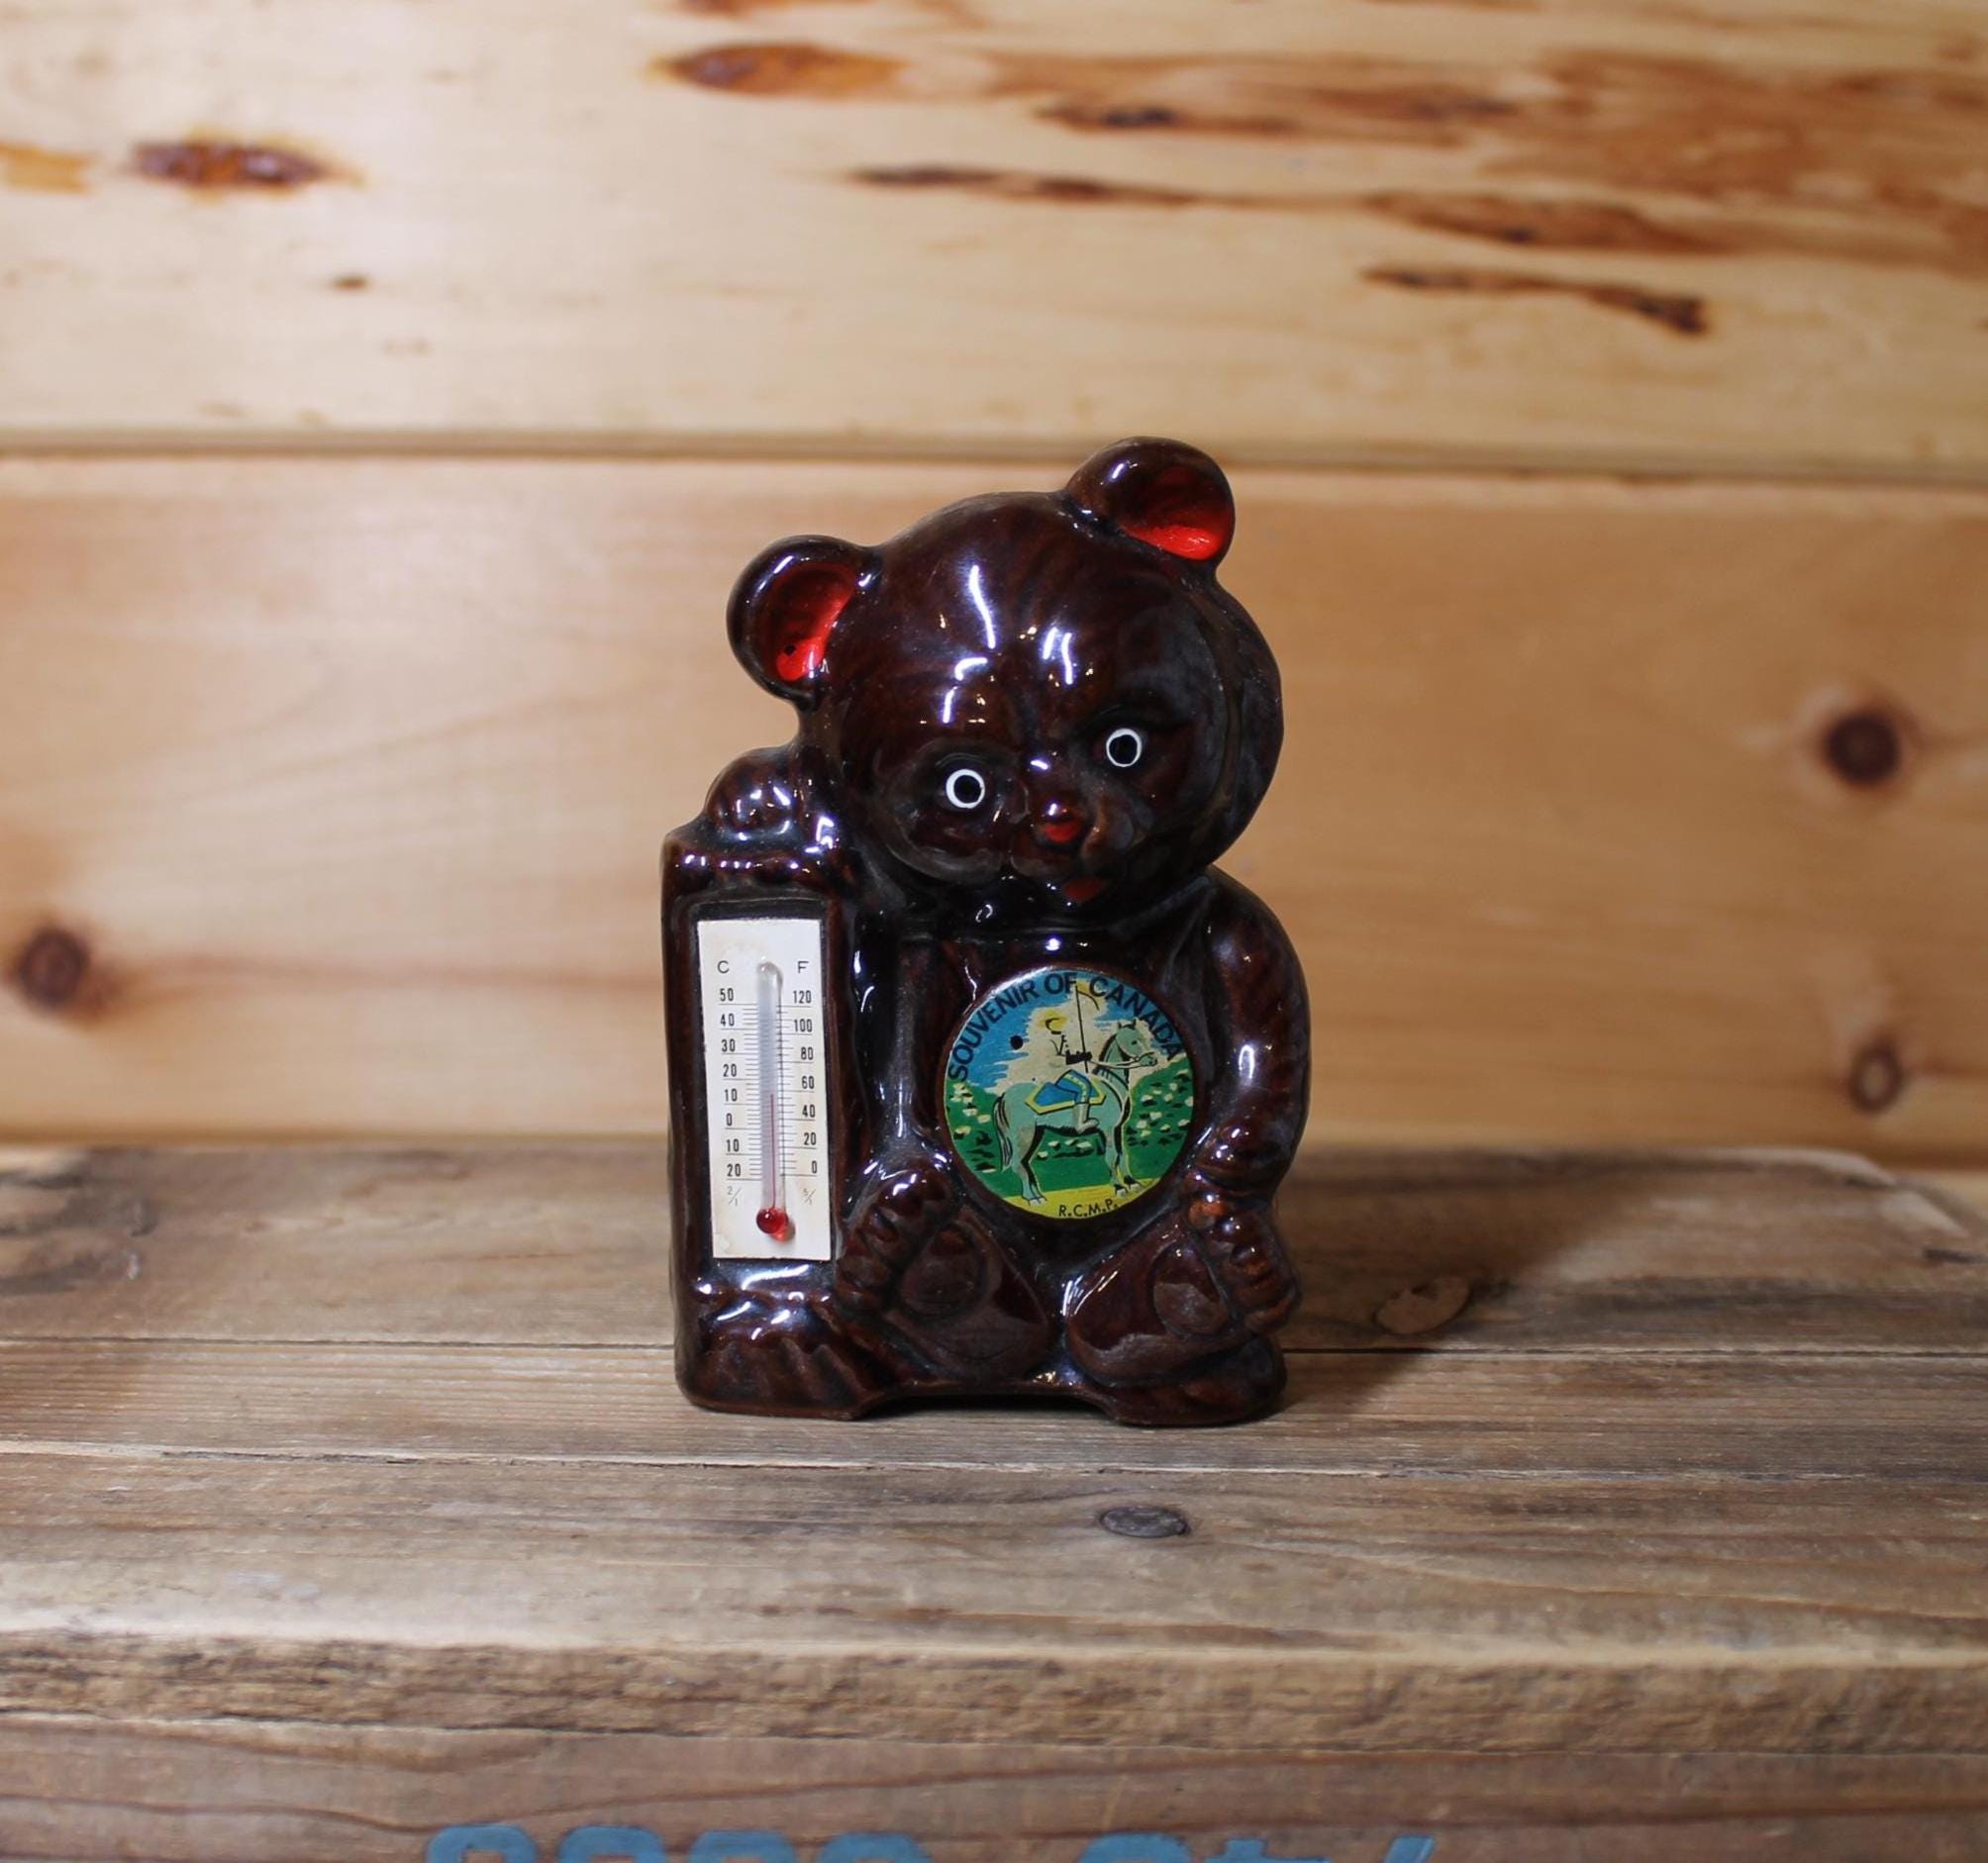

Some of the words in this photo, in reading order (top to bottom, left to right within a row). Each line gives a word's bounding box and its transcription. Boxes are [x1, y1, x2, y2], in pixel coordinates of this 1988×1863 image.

[717, 960, 730, 974] C
[797, 960, 809, 974] F
[720, 988, 735, 1002] 50
[793, 990, 812, 1004] 120
[720, 1013, 735, 1027] 40
[794, 1019, 813, 1032] 100
[947, 979, 1039, 1082] SOUVENIR
[1044, 972, 1078, 996] OF
[1089, 976, 1184, 1061] CANADA
[721, 1038, 736, 1052] 30
[800, 1046, 814, 1060] 80
[723, 1063, 738, 1077] 20
[801, 1076, 815, 1090] 60
[725, 1088, 738, 1102] 10
[802, 1104, 816, 1119] 40
[726, 1113, 733, 1127] 0
[726, 1138, 740, 1152] 10
[803, 1132, 817, 1146] 20
[727, 1163, 742, 1177] 20
[811, 1160, 818, 1174] 0
[1058, 1199, 1118, 1218] R.C.M.P.
